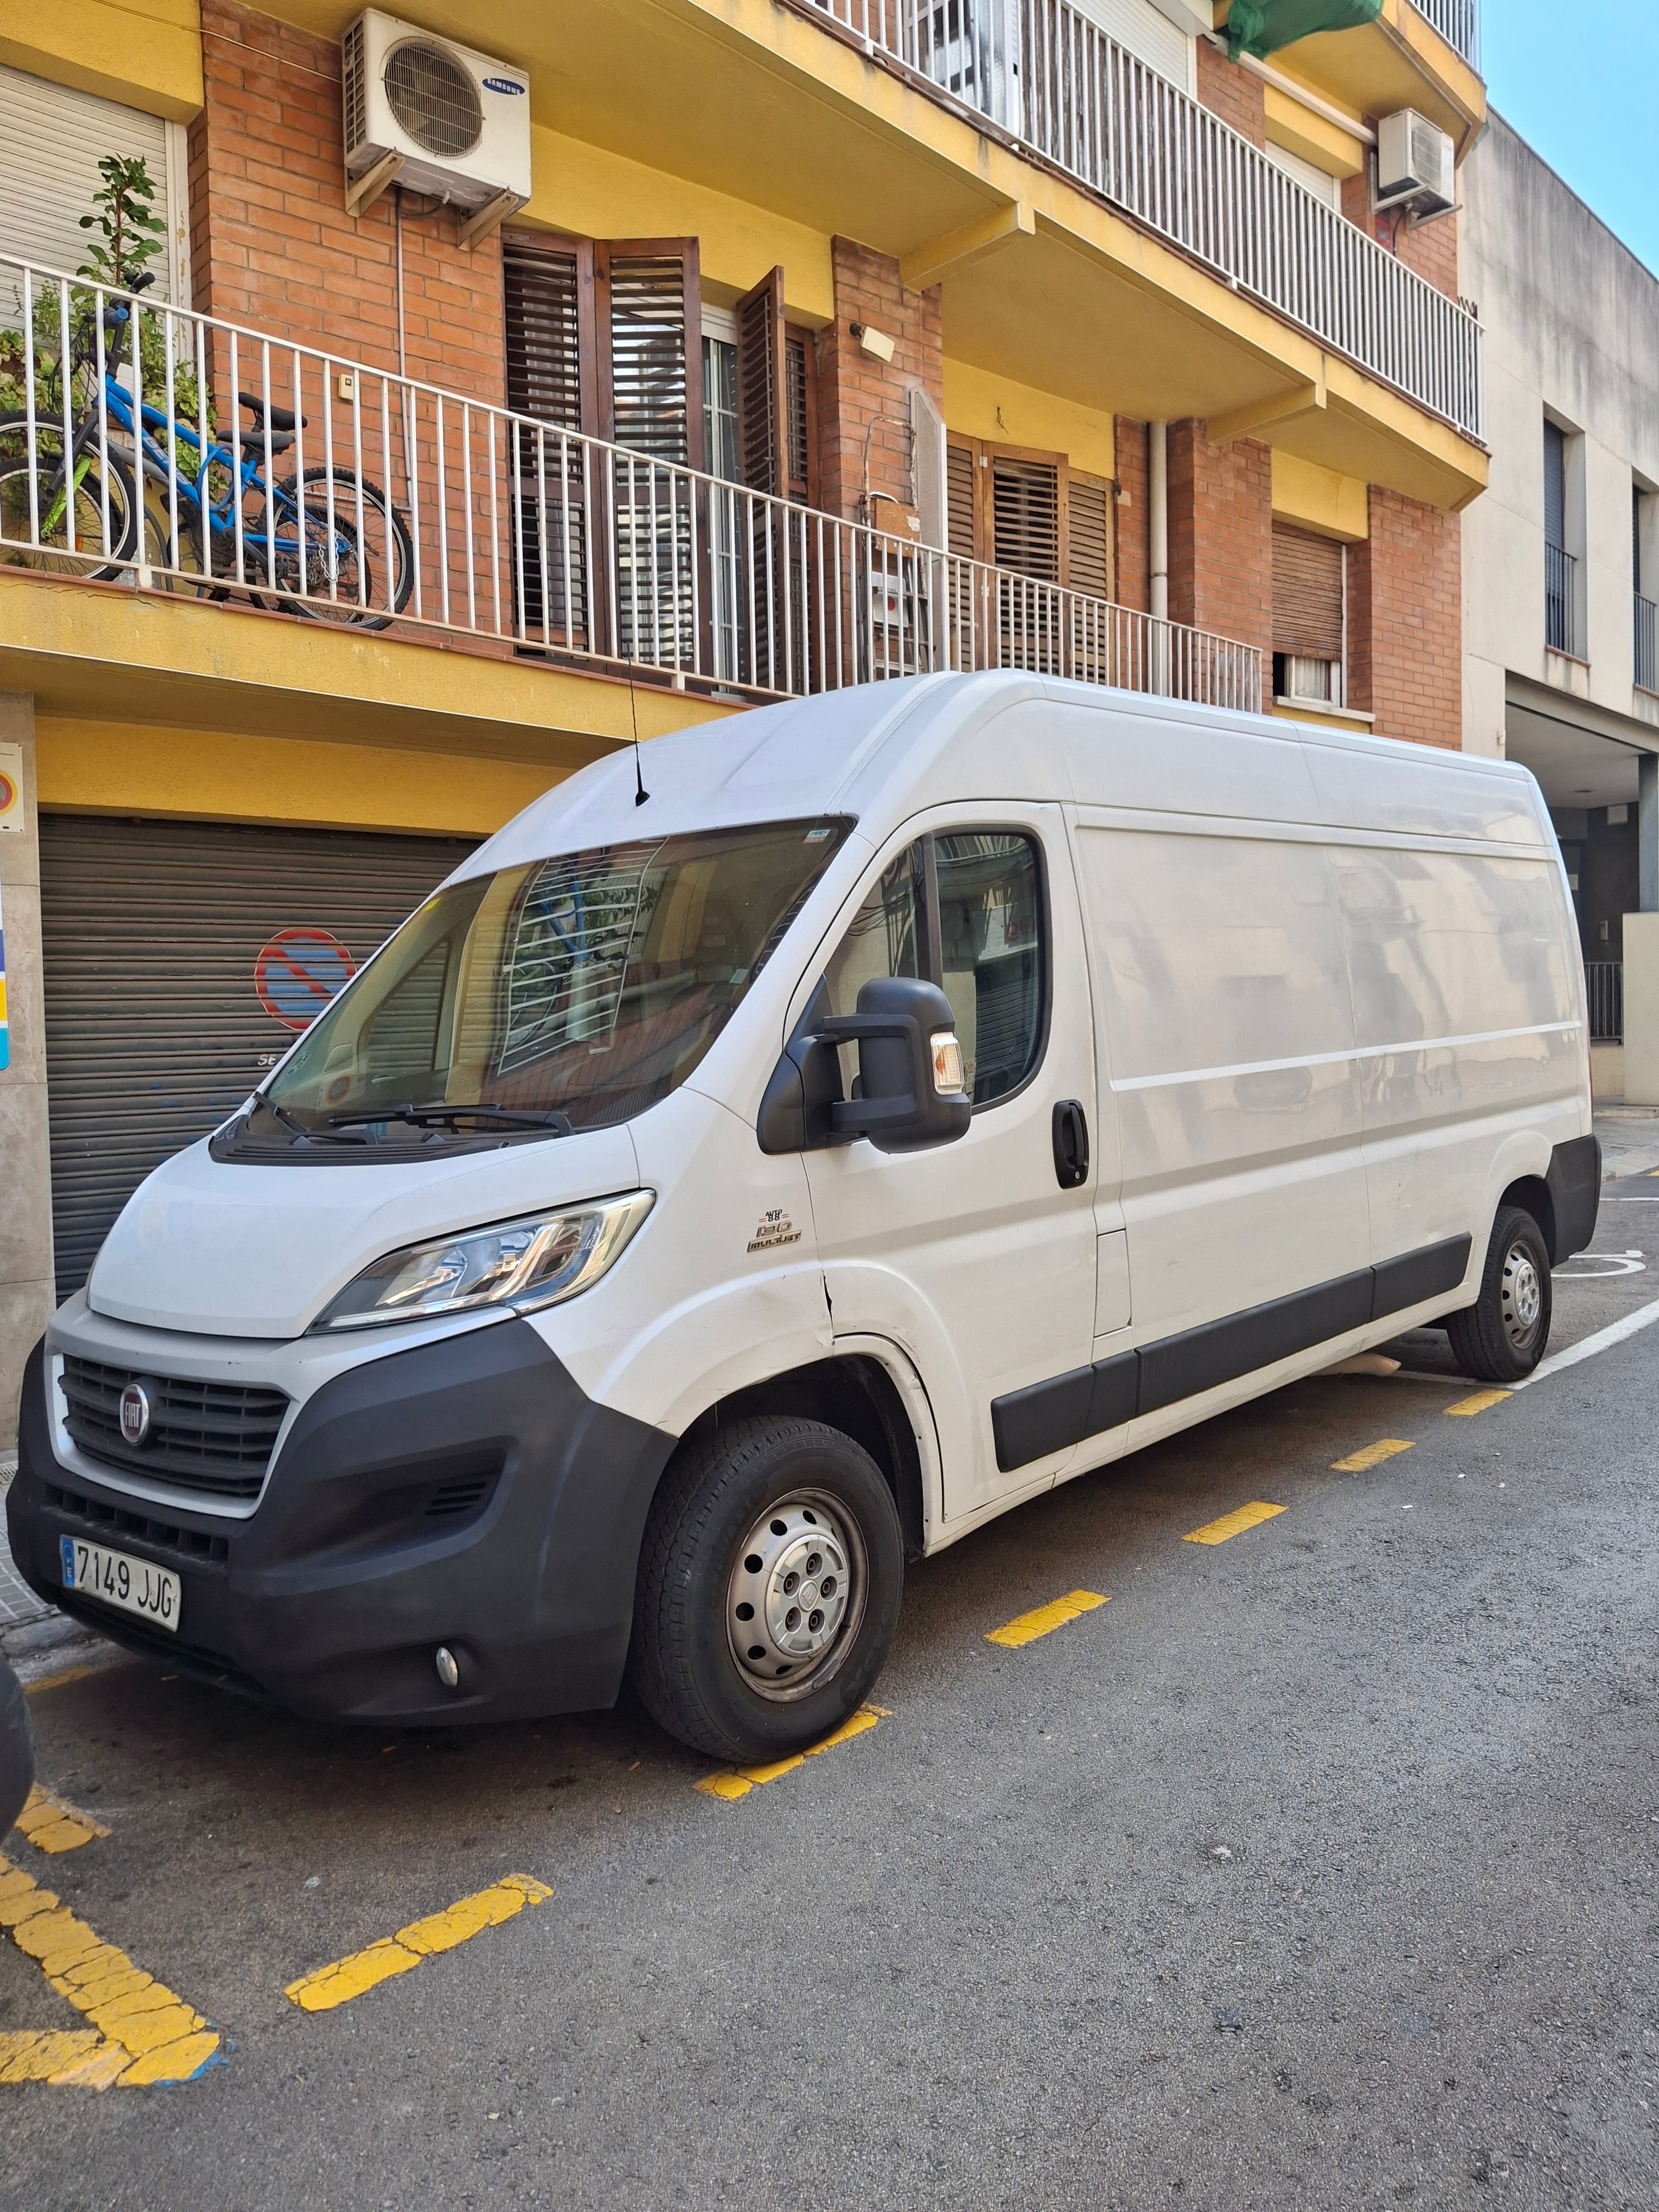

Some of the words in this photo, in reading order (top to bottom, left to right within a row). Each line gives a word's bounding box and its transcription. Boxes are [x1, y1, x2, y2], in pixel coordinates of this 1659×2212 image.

[487, 78, 520, 95] SAMSUNG
[768, 1213, 780, 1221] 88
[756, 1221, 792, 1237] 130
[125, 1401, 141, 1428] FIAT
[67, 1567, 72, 1578] E
[78, 1546, 130, 1599] 7149
[138, 1569, 172, 1618] JJG
